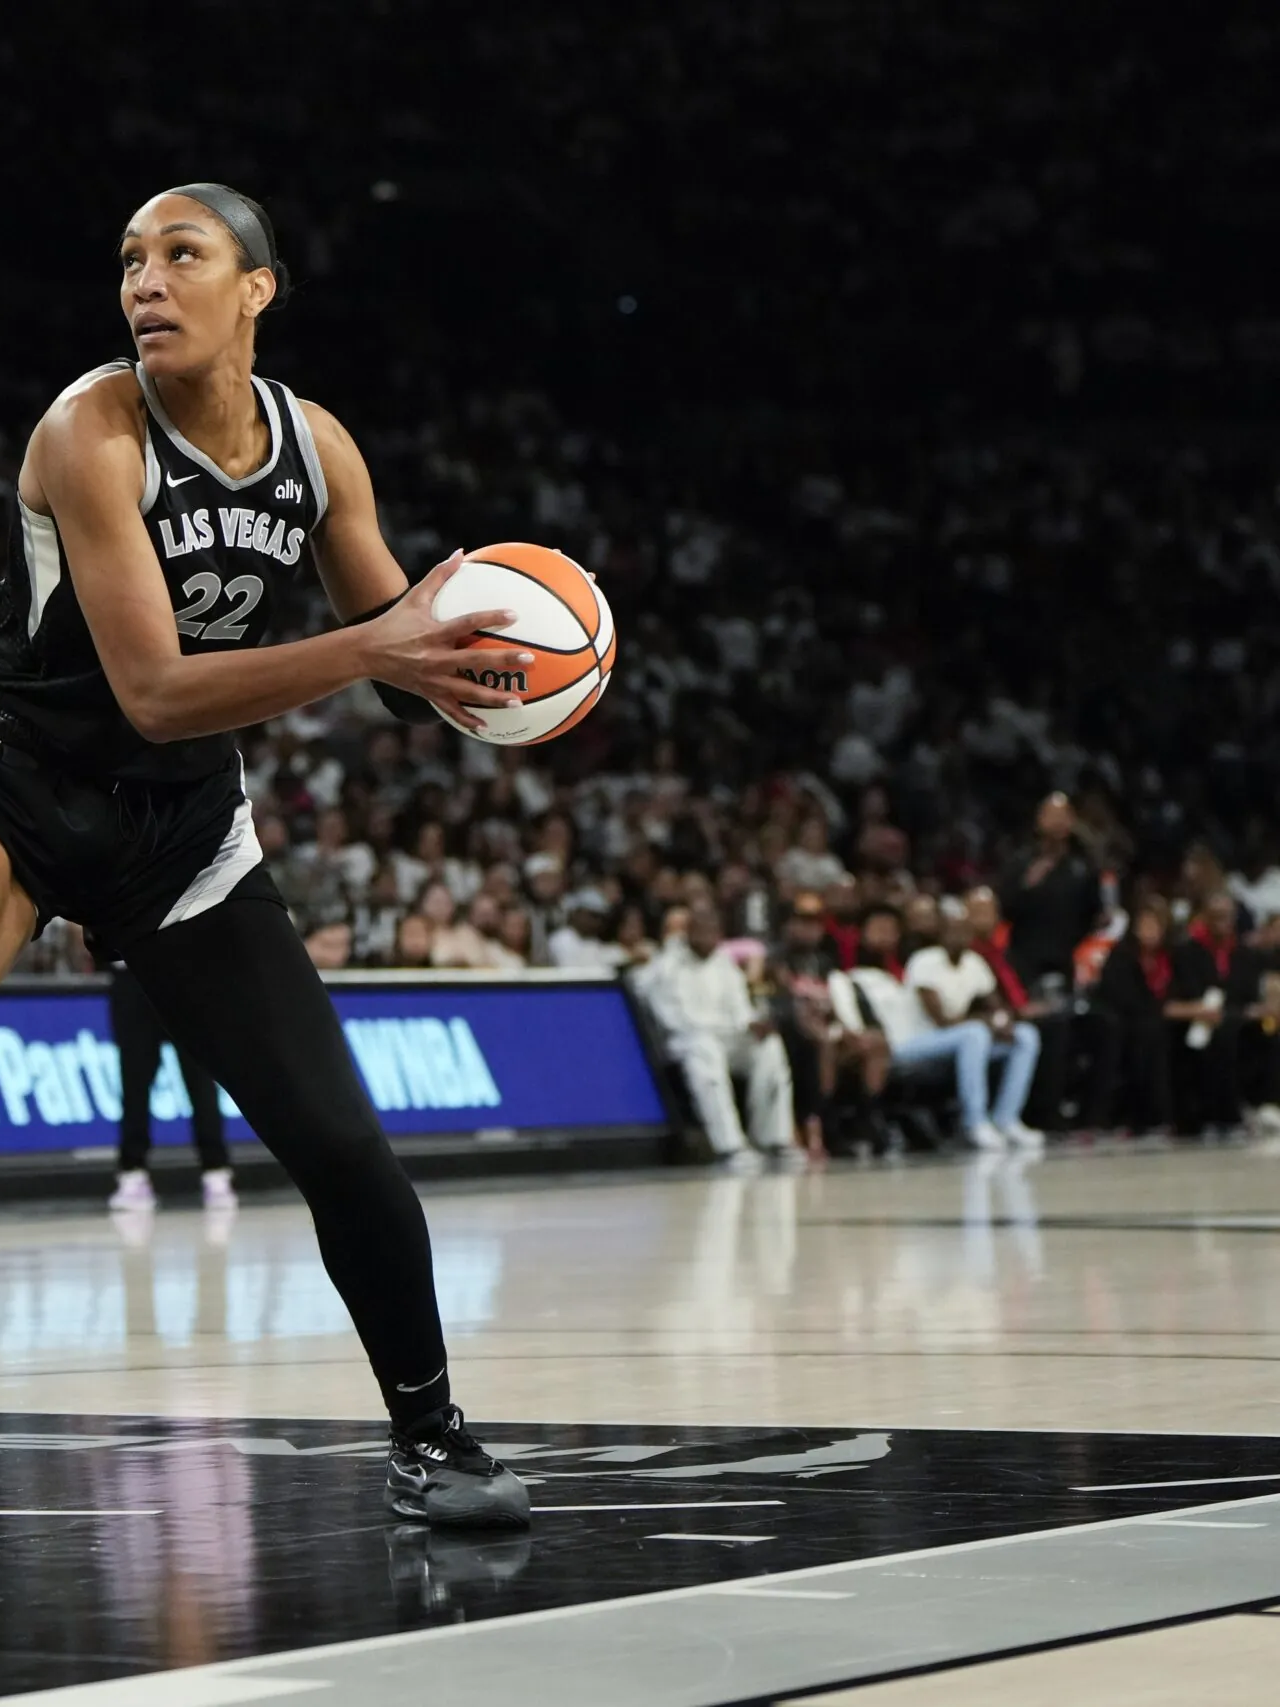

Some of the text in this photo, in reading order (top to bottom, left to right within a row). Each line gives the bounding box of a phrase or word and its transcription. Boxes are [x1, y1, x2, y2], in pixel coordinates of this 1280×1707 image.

[274, 479, 303, 504] ally
[158, 507, 305, 566] LAS VEGAS
[174, 571, 264, 640] 22
[343, 1016, 502, 1111] WNBA
